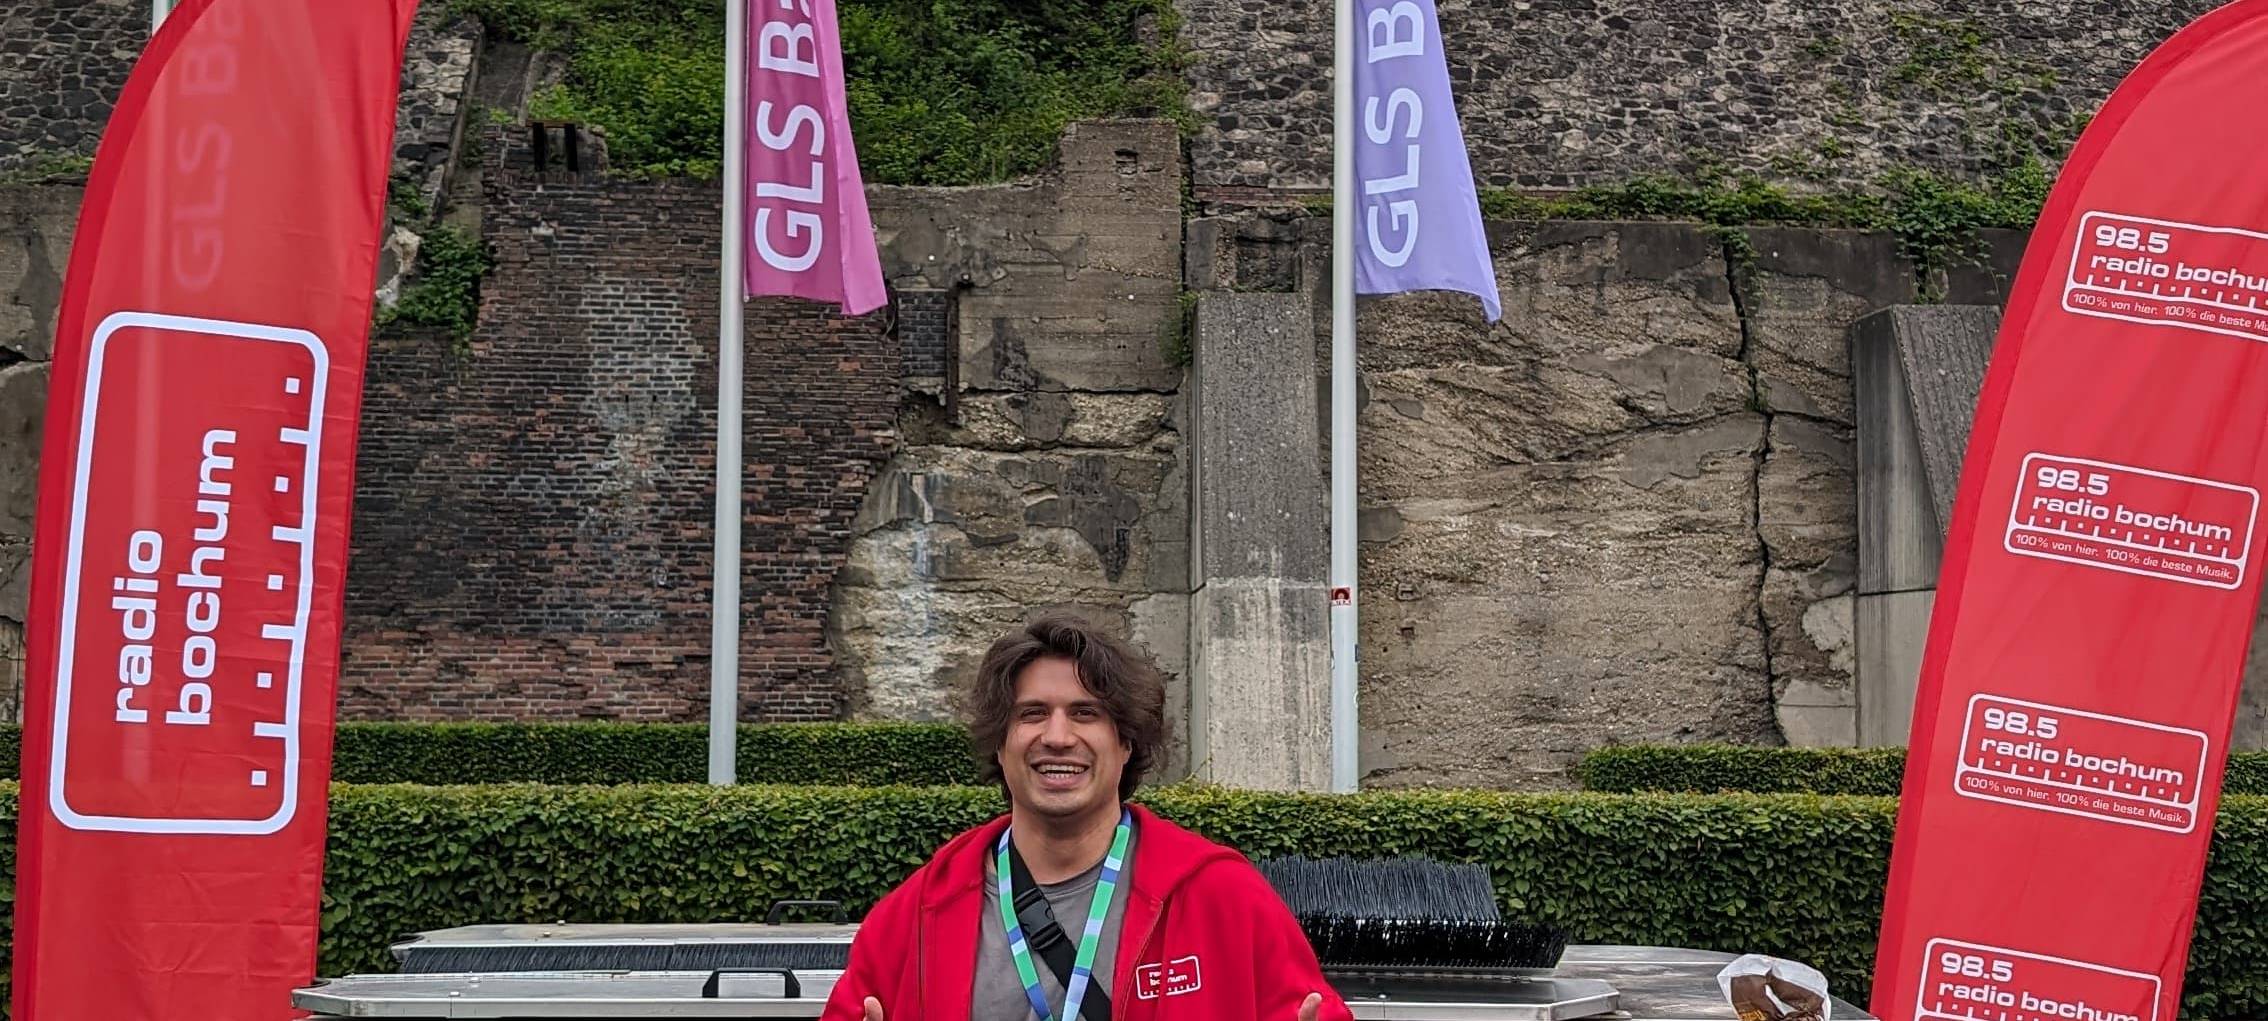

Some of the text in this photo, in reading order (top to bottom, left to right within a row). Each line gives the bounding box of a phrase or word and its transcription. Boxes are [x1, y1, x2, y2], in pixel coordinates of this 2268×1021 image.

[1365, 0, 1424, 268] GLS B
[169, 121, 233, 293] GLS
[755, 100, 825, 273] GLS
[2095, 224, 2170, 254] 98.5
[2090, 254, 2268, 293] radio bochu
[2073, 293, 2107, 308] 100%
[2111, 300, 2131, 311] von
[2134, 302, 2158, 316] hier.
[2164, 305, 2197, 320] 100%
[2199, 310, 2216, 322] die
[2218, 313, 2252, 328] beste
[2037, 466, 2110, 496] 98.5
[2032, 496, 2232, 542] radio bochum
[165, 429, 237, 725] bochum
[2015, 534, 2233, 580] 100% von hier. 100% die beste Musik.
[112, 530, 163, 723] radio
[1984, 707, 2058, 739] 98.5
[1981, 738, 2184, 786] radio bochum
[1965, 776, 2186, 824] 100% von hier. 100% die beste Musik.
[1940, 952, 2014, 982] 98.5
[1938, 982, 2015, 1007] radio
